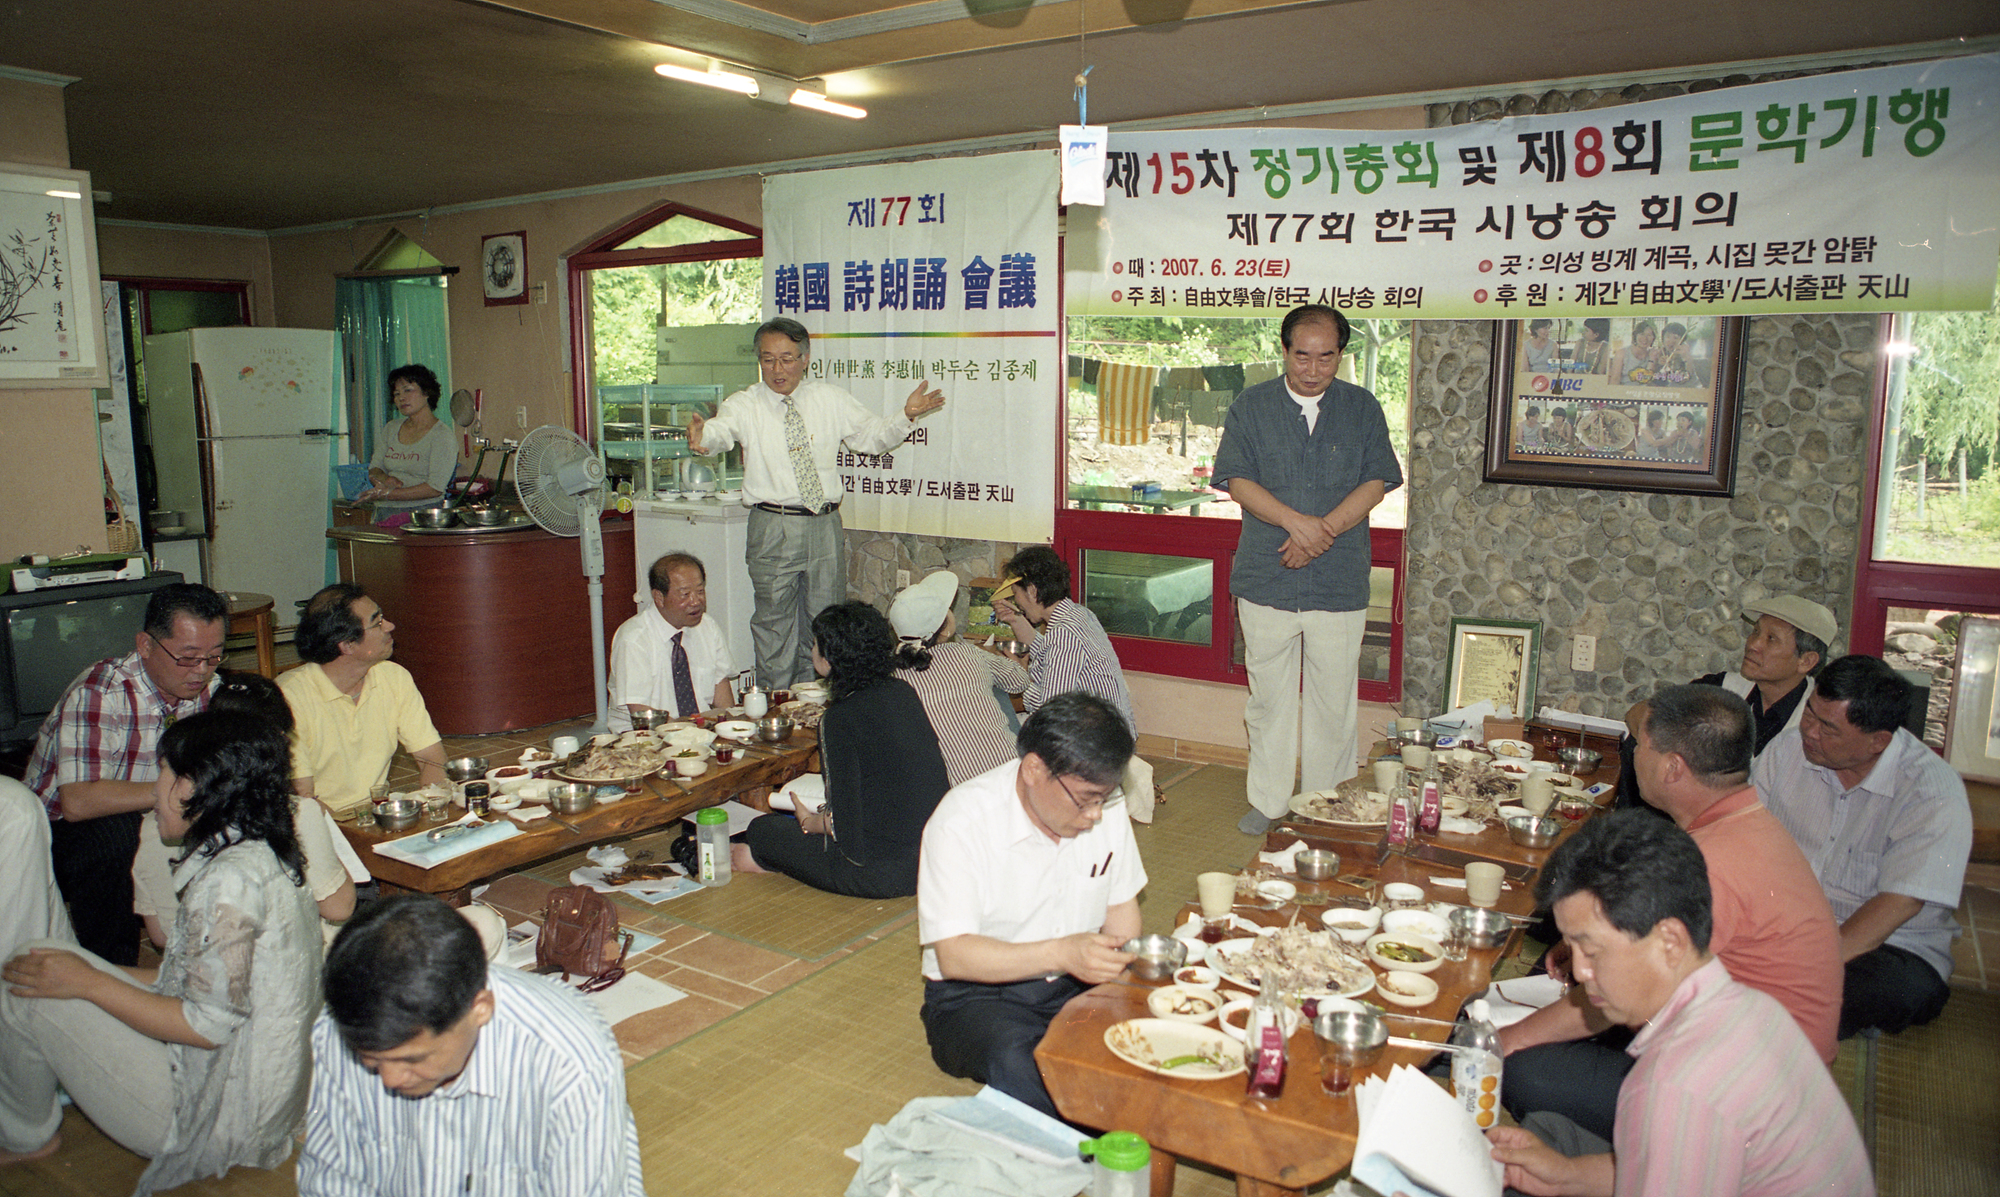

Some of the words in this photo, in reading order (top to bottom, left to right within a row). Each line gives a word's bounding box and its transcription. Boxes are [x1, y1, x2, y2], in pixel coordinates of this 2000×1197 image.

[1105, 148, 1240, 199] 제15차
[1250, 140, 1439, 200] 정기총회
[1458, 145, 1497, 187] 및
[1517, 119, 1662, 183] 제8회
[1688, 86, 1950, 172] 문학기행
[847, 192, 945, 228] 제77회
[1226, 211, 1355, 246] 제77회
[1375, 207, 1457, 243] 한국
[1475, 199, 1617, 241] 시낭송
[1638, 191, 1739, 232] 회의
[1128, 257, 1144, 279] 때
[1161, 258, 1204, 277] 2007.
[1211, 258, 1226, 277] 6.
[1234, 258, 1291, 279] 23(토)
[1499, 255, 1522, 276] 곳
[1539, 251, 1585, 274] 의성
[1591, 247, 1638, 273] 빙계
[1643, 245, 1698, 271] 계곡,
[1705, 242, 1757, 269] 시집
[1763, 238, 1817, 267] 못간
[774, 262, 830, 315] 韓國
[843, 257, 947, 313] 詩朗誦
[960, 252, 1037, 311] 會議
[1316, 286, 1376, 309] 시낭송
[1382, 286, 1424, 310] 회의
[1856, 273, 1910, 300] 天山
[931, 358, 980, 381] 박두순
[987, 359, 1037, 382] 김종제
[985, 484, 1014, 503] 天山
